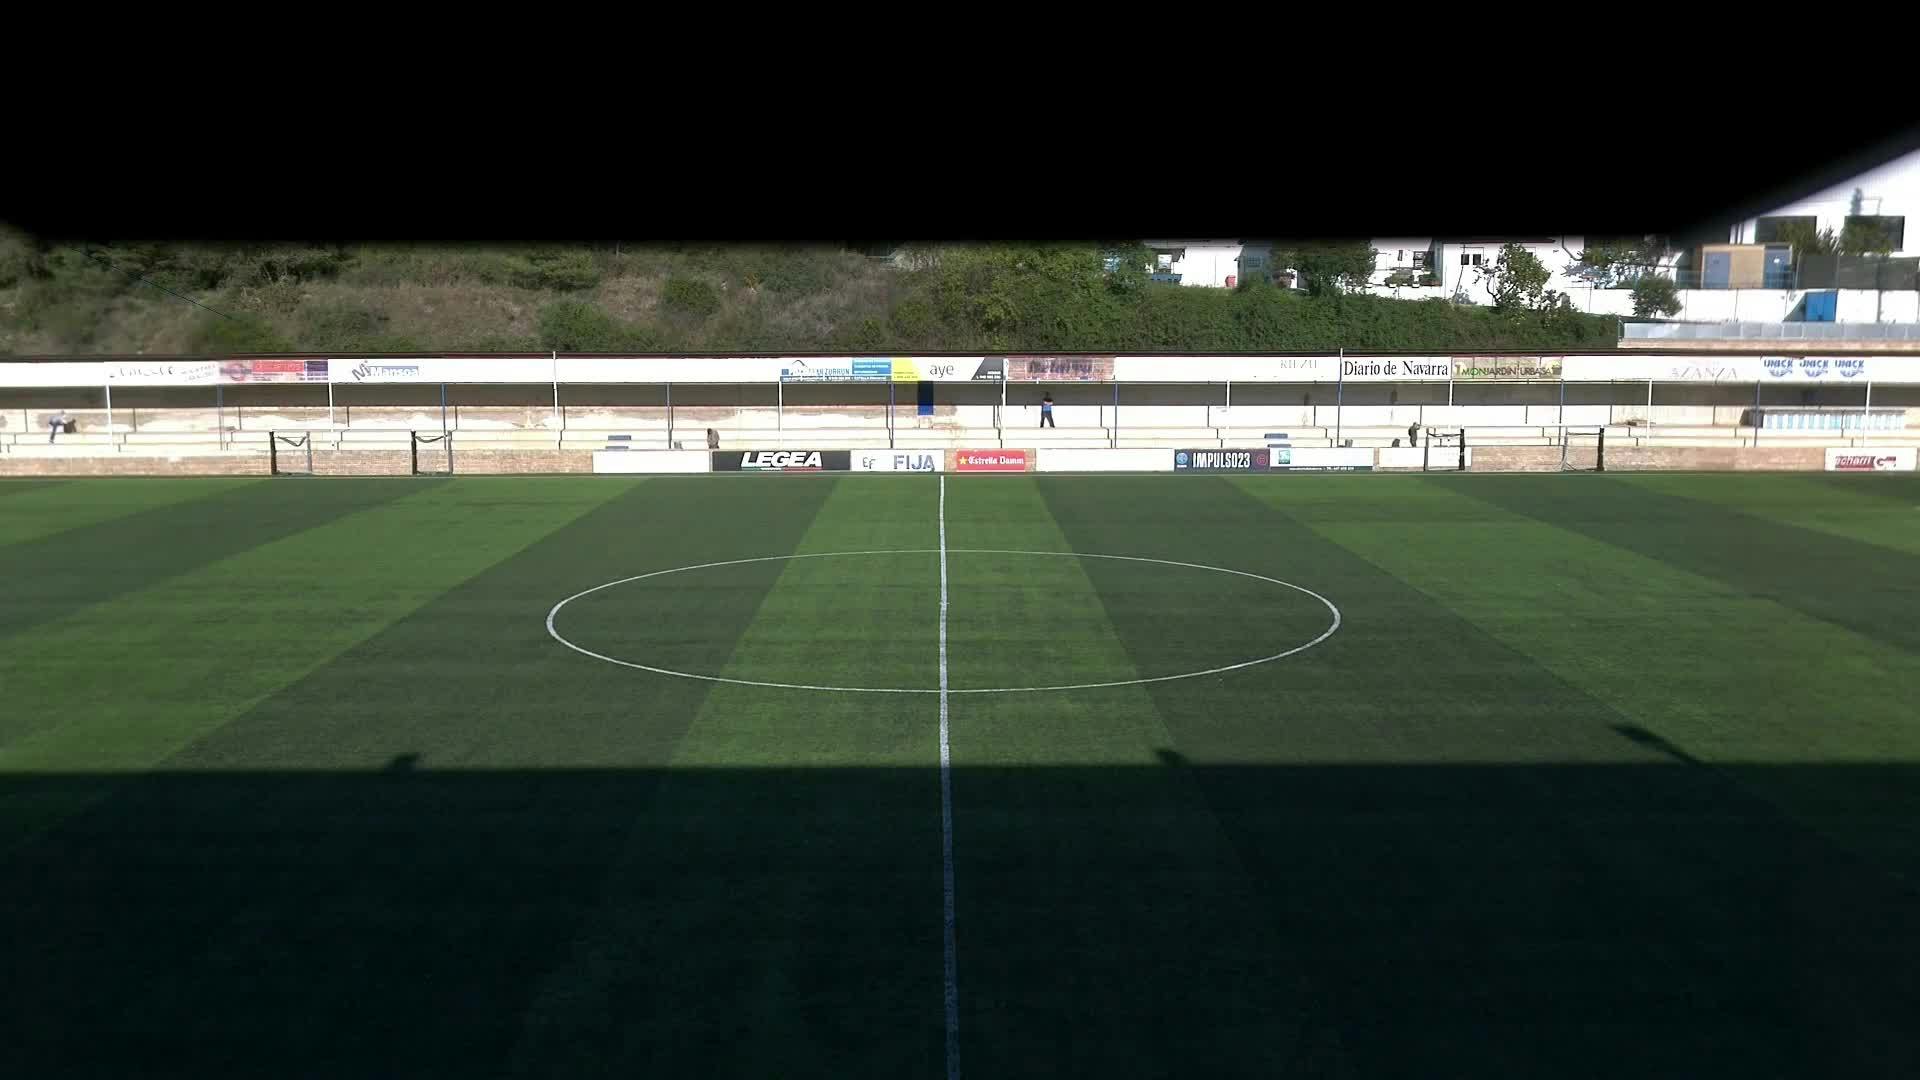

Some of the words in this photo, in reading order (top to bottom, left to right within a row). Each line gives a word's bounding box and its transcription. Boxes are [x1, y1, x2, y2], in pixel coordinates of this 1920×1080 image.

[929, 364, 955, 379] aye
[1344, 360, 1380, 375] Diario
[1383, 360, 1397, 375] de
[1402, 360, 1449, 375] Navarra
[740, 451, 823, 468] LEGEA
[893, 454, 935, 470] FIJA
[968, 455, 998, 465] Estrella
[1000, 455, 1024, 465] Damm
[1192, 452, 1251, 468] IMPULSO23
